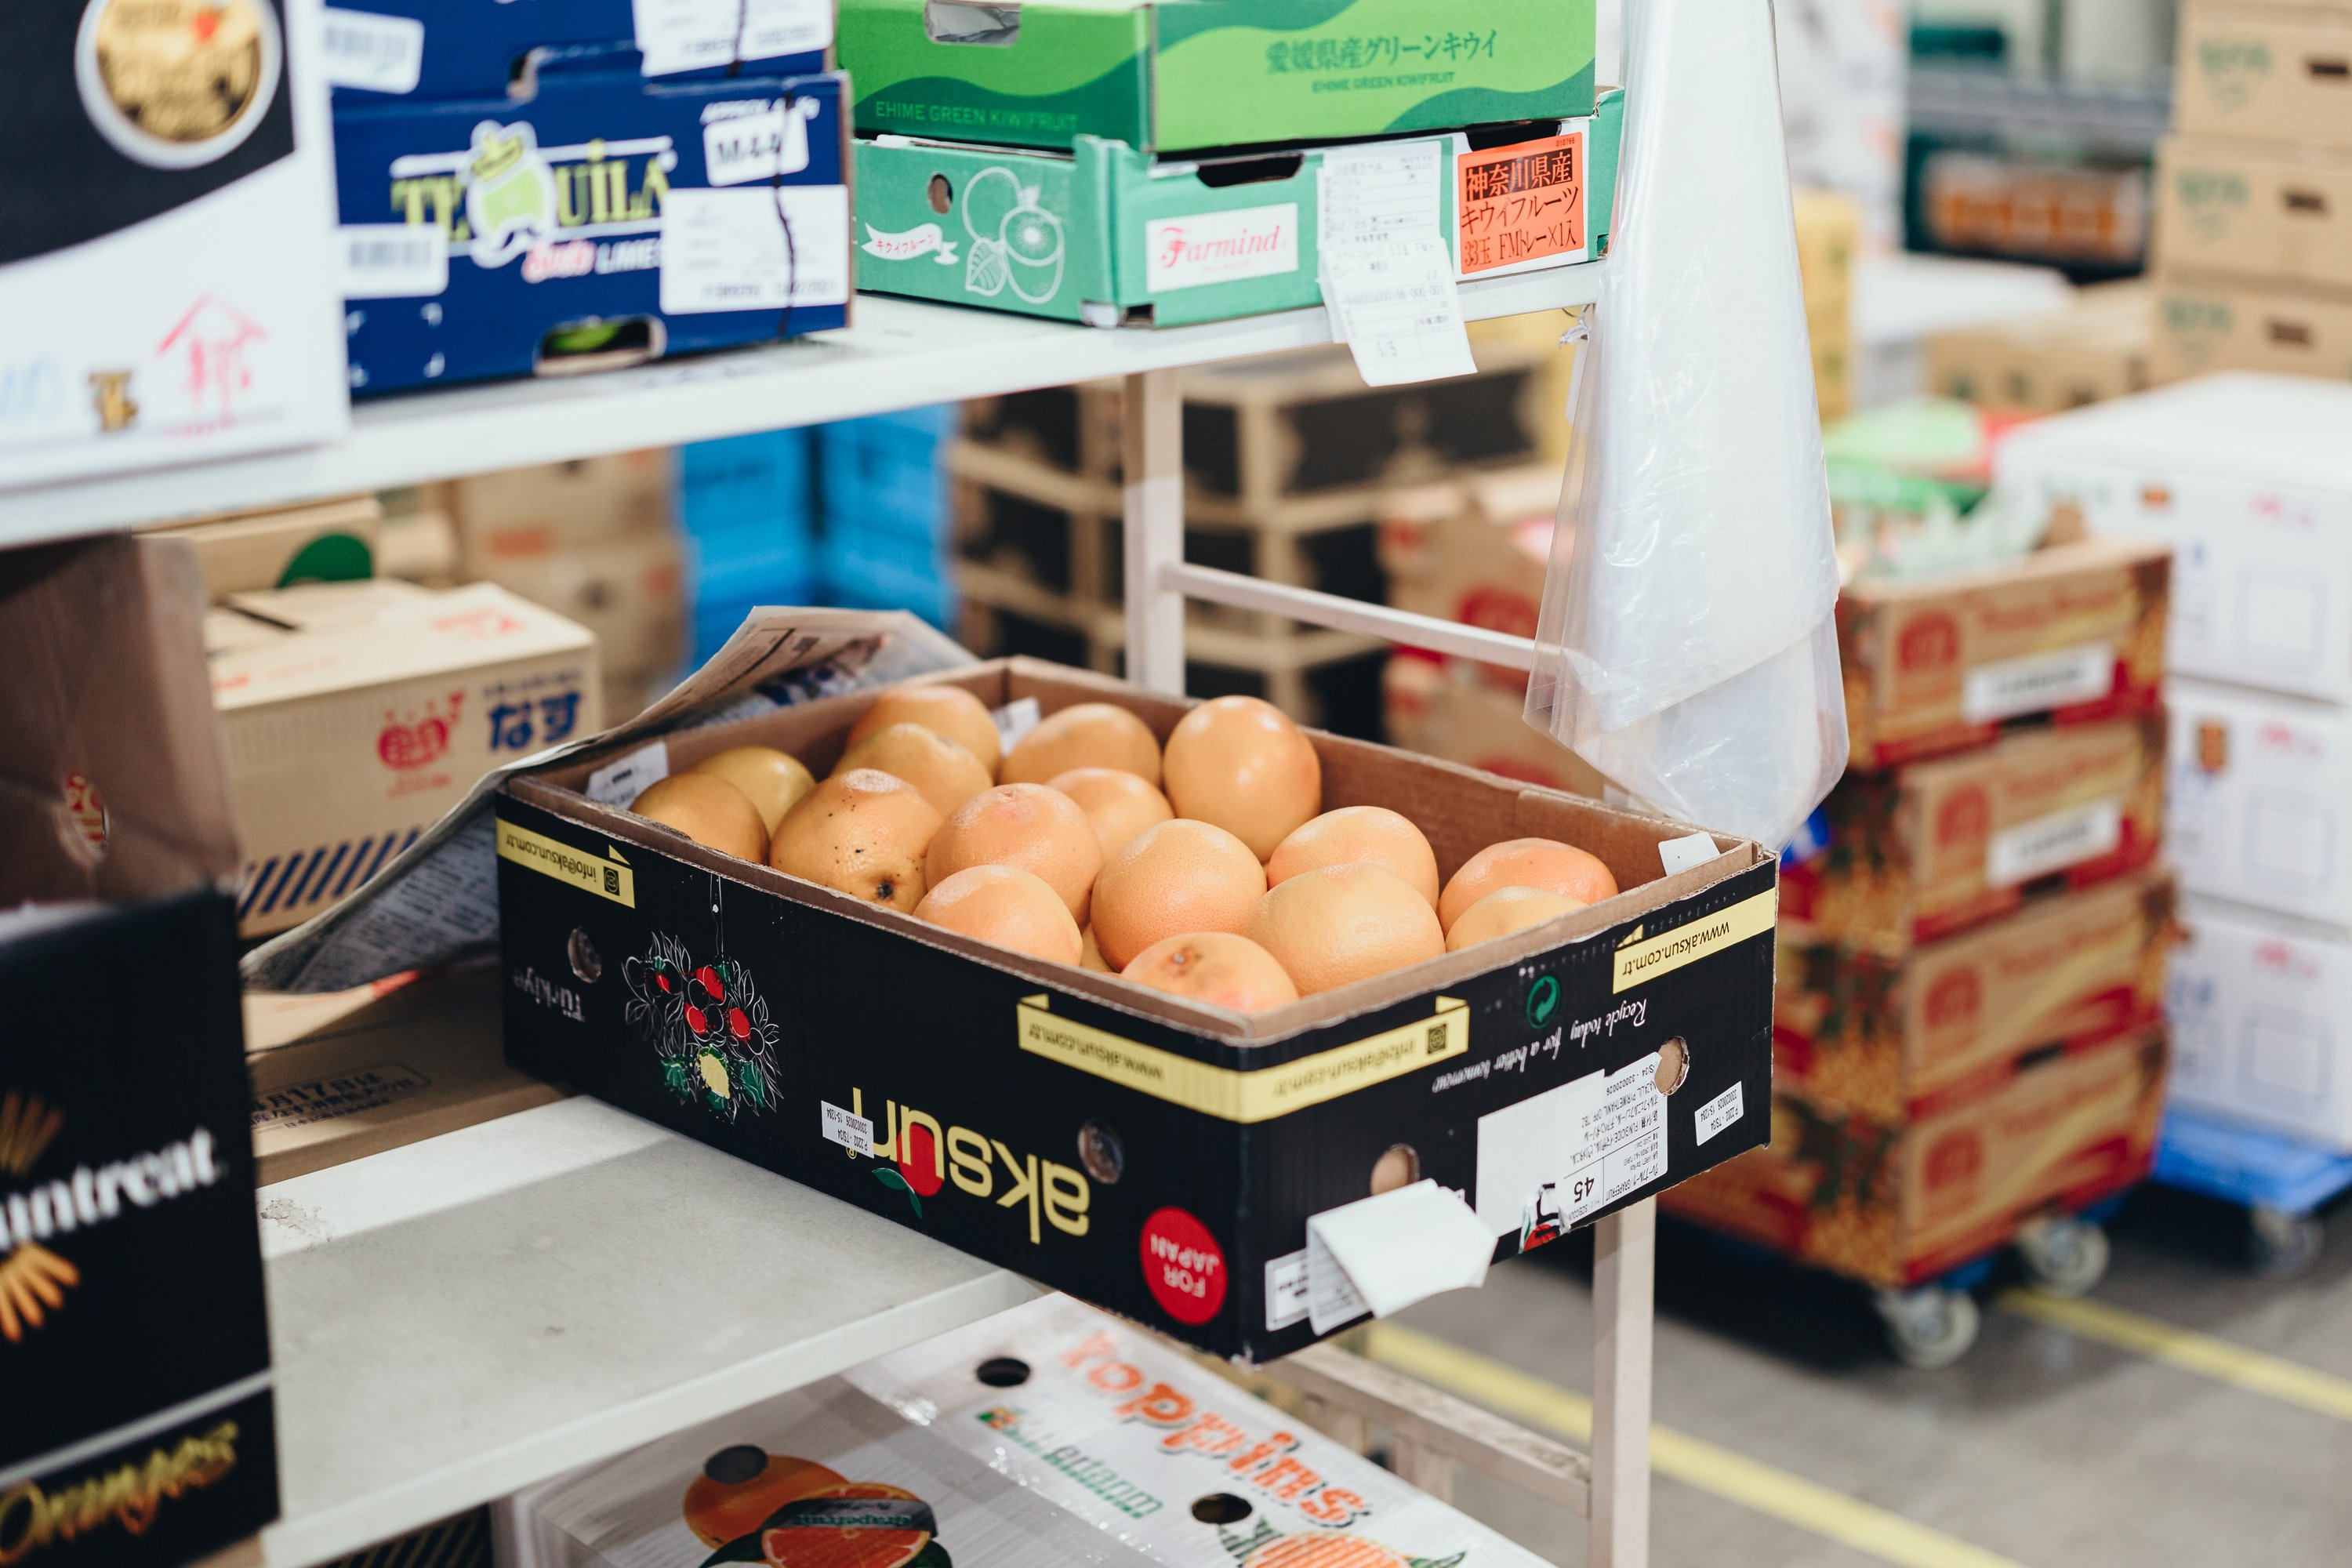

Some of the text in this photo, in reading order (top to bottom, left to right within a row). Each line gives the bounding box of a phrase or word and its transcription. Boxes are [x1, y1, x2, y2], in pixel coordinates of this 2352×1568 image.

[1265, 30, 1497, 74] 愛媛県産グリーンキウイ
[1353, 75, 1393, 89] GREEN
[876, 101, 1079, 132] EHIME GREEN KIWIFRUIT
[1467, 152, 1572, 201] 神奈川県産
[1161, 226, 1279, 269] Farmind
[1464, 237, 1492, 267] 33玉
[488, 690, 581, 753] なす
[506, 833, 597, 883] info@aksun.com.tr
[1621, 921, 1730, 976] www.aksun.com.tr
[1029, 1023, 1166, 1080] www.aksun.com.tr
[1432, 998, 1647, 1093] Recycle today for a better tomorrow
[1606, 1074, 1635, 1096] 330020026
[852, 1087, 1091, 1245] aksun
[1573, 1177, 1595, 1203] 45
[1150, 1233, 1221, 1276] JAPAN
[1163, 1263, 1207, 1298] FOR
